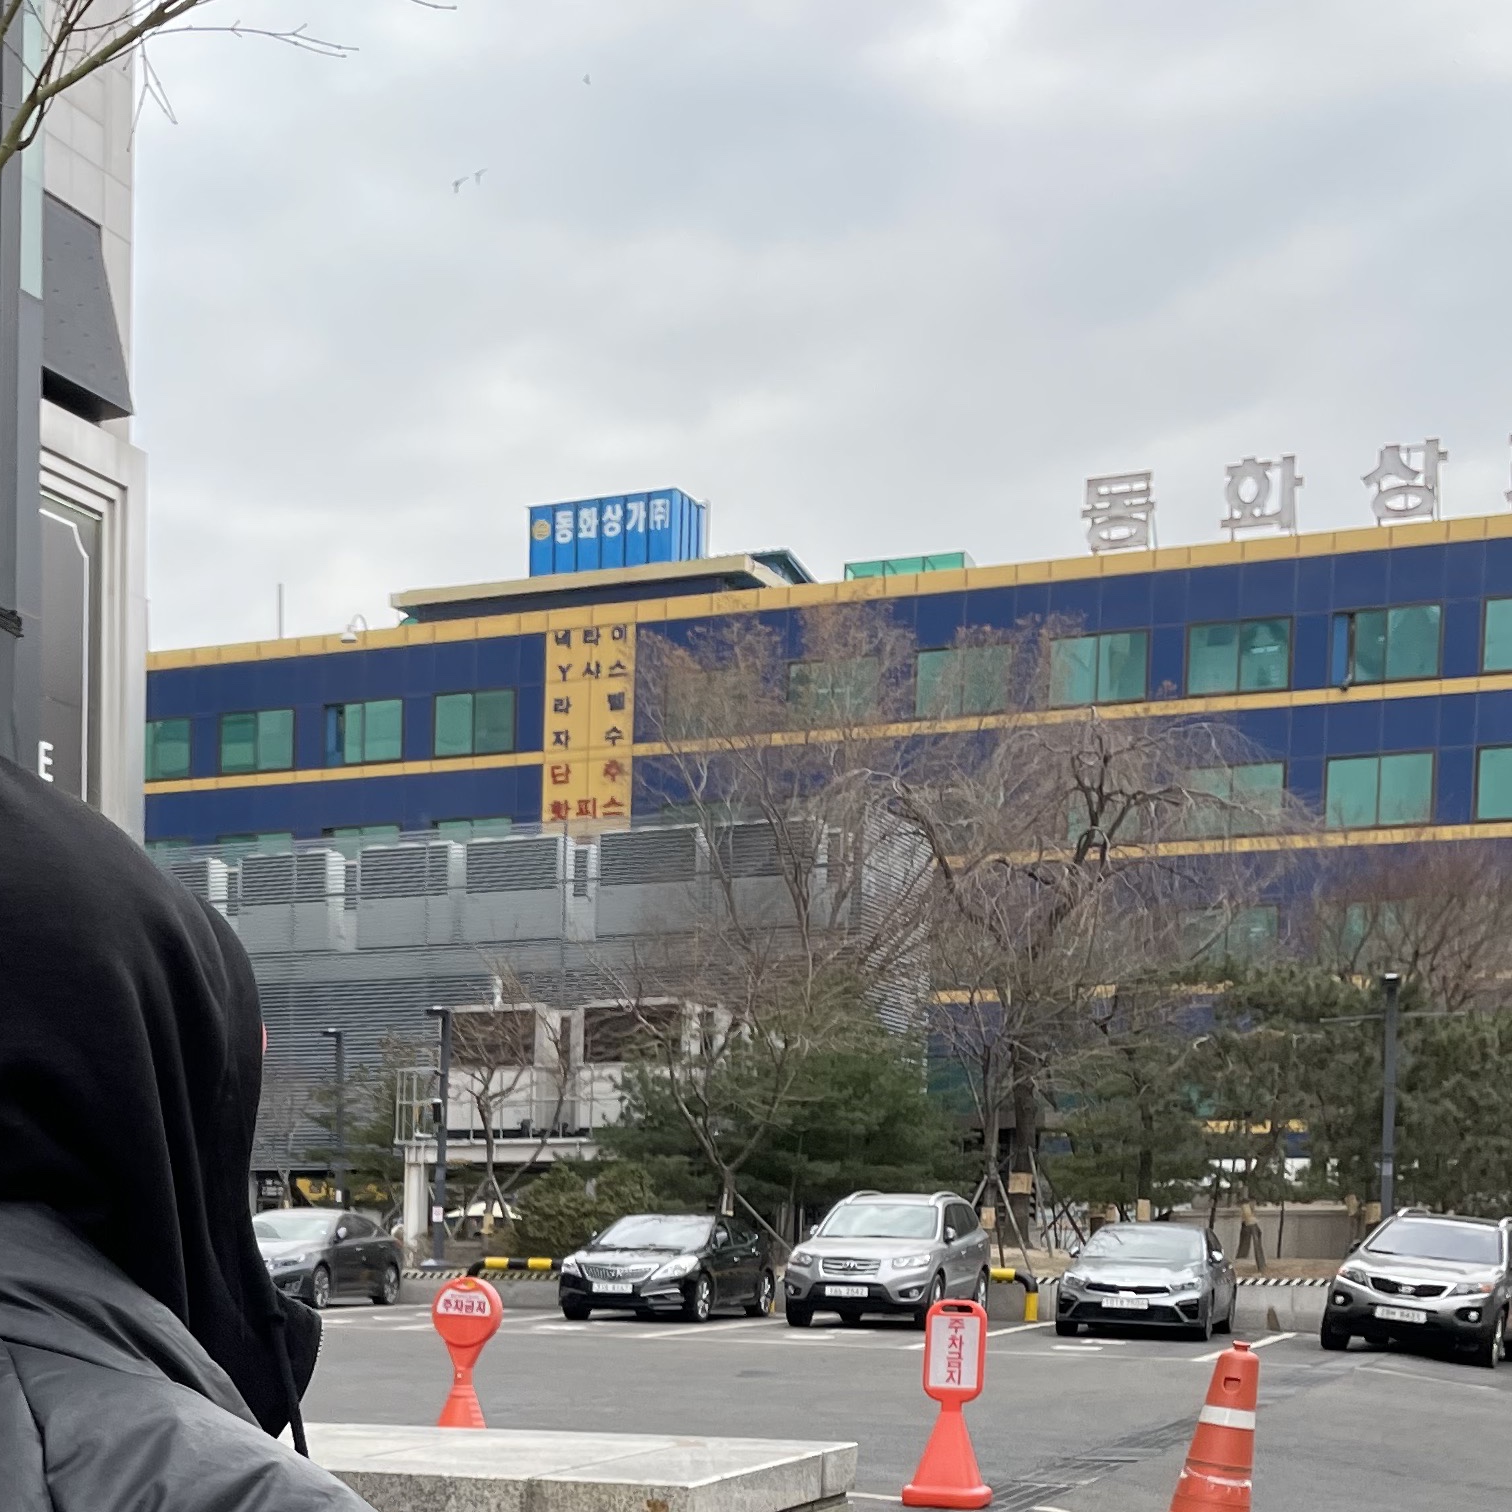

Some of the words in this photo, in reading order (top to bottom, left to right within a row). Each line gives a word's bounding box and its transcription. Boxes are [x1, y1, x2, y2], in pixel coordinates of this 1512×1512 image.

[1080, 437, 1512, 554] 동화상
[443, 1298, 486, 1314] 주차금지
[945, 1318, 966, 1386] 주차금지
